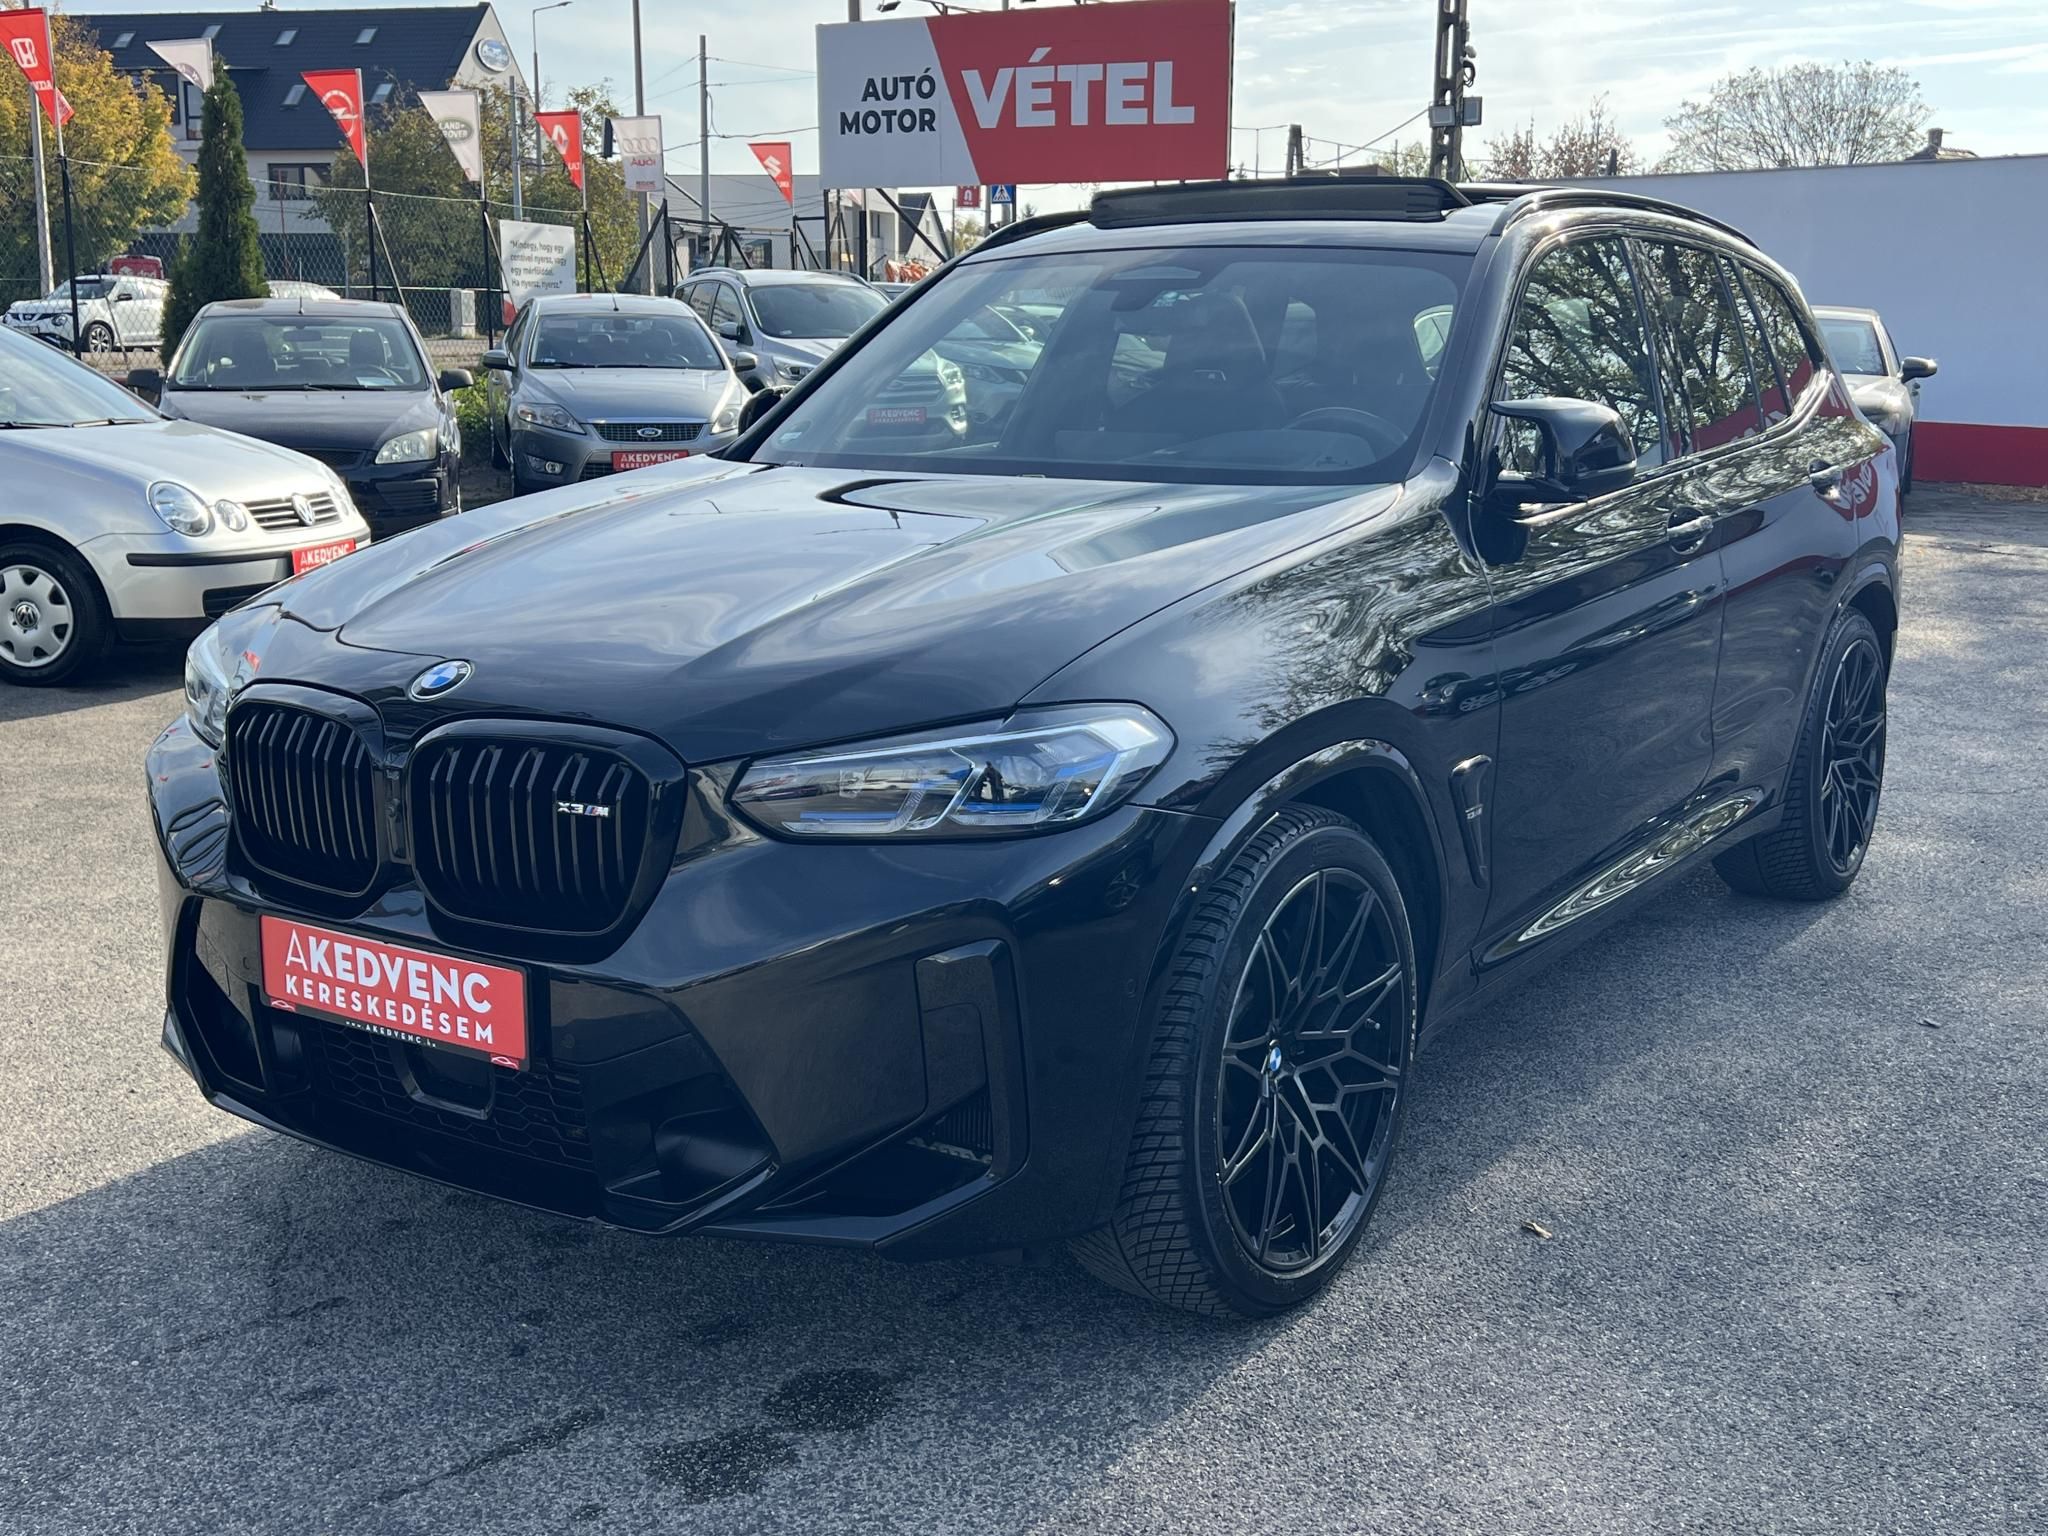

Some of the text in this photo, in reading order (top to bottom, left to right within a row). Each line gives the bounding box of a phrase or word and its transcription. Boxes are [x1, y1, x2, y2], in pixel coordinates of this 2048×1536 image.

[861, 67, 936, 102] AUTÓ
[961, 46, 1195, 129] VÉTEL
[439, 122, 460, 130] LAND
[840, 108, 936, 135] MOTOR
[630, 157, 656, 167] Audi
[558, 801, 584, 814] X3
[285, 973, 493, 1044] KERESKEDÉSEM
